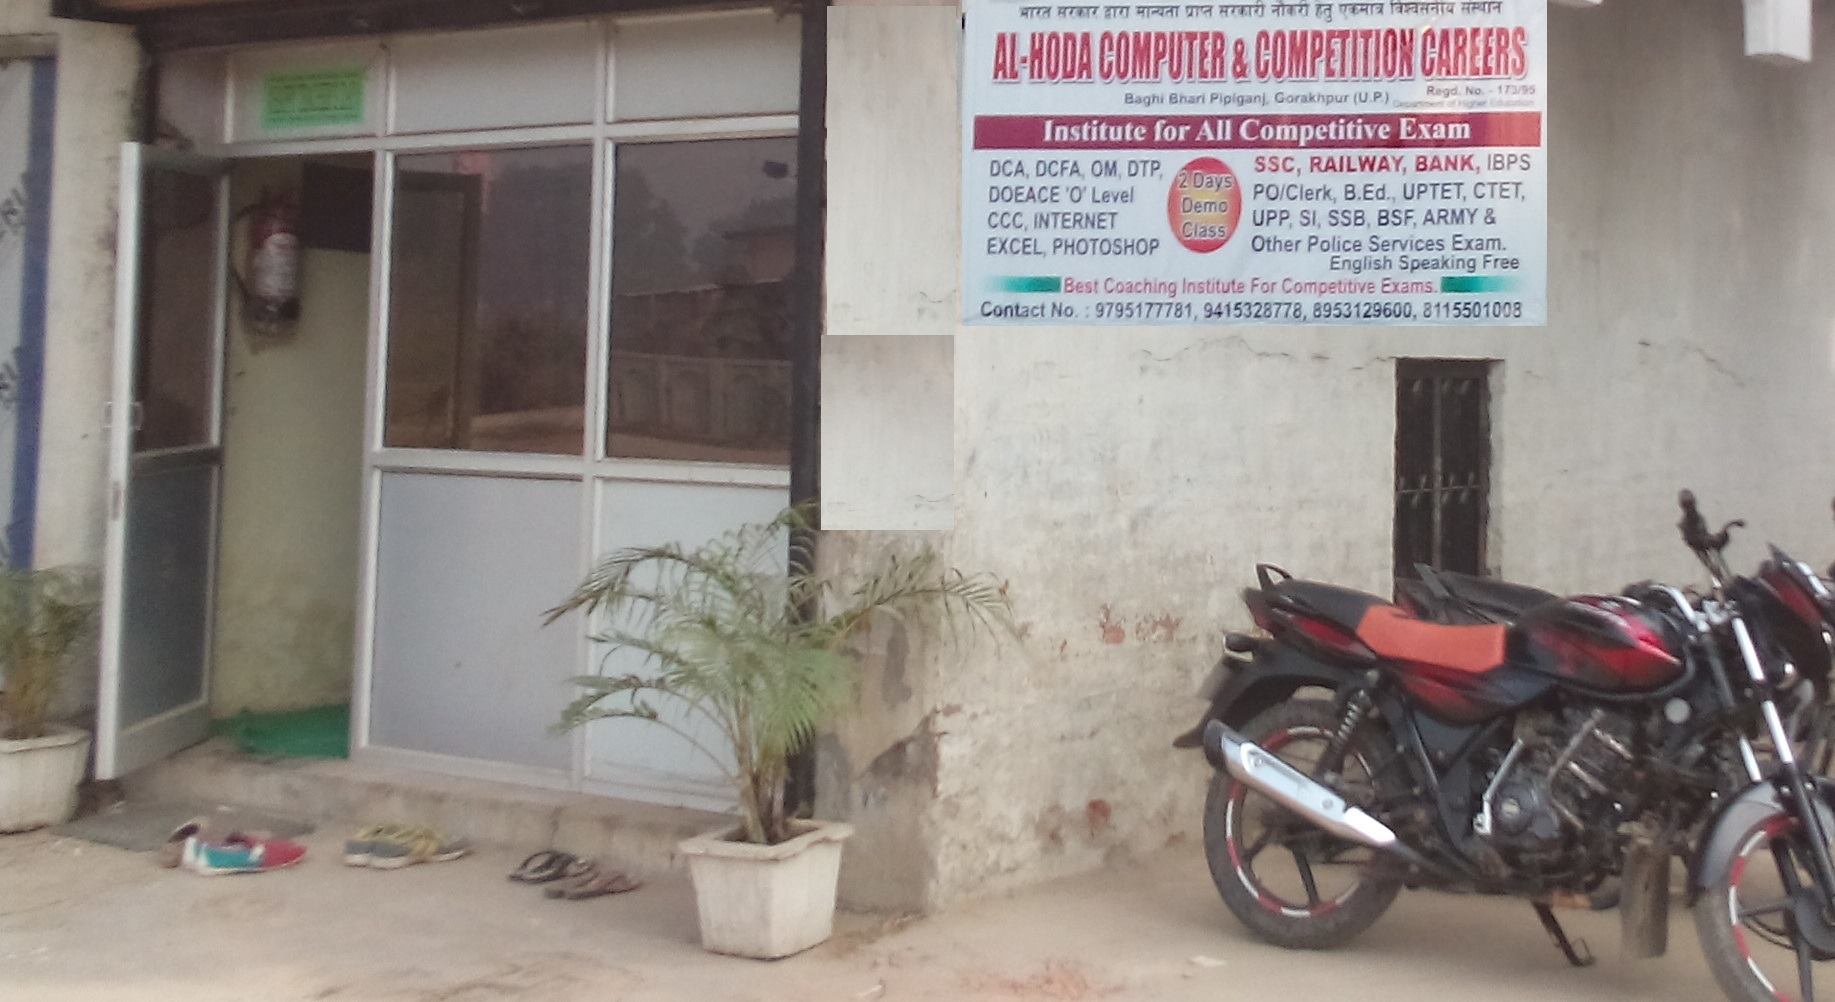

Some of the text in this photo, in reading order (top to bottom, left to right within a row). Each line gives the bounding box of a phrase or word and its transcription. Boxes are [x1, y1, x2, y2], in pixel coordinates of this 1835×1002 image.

[1057, 5, 1099, 18] सरकार
[1136, 4, 1180, 18] मान्यता
[992, 25, 1530, 83] AL-HODA COMPUTER & COMPETITION CAREERS
[1124, 93, 1164, 106] Baghi
[1168, 93, 1206, 104] Bhari
[1274, 91, 1349, 106] Gorakhpur
[1043, 117, 1472, 147] Institute for All Competitive Exam
[989, 159, 1164, 179] DCA, DCFA, OM, DTP,
[1253, 152, 1532, 177] SSC, RAILWAY, BANK, IBPS
[1178, 171, 1233, 192] 2 Days
[1252, 183, 1338, 202] PO/Clerk,
[1402, 182, 1468, 201] UPTET,
[1472, 180, 1526, 201] CTET,
[988, 186, 1061, 204] DOEACE
[1091, 185, 1135, 204] Level
[1181, 196, 1228, 214] Demo
[987, 211, 1119, 232] CCC, INTERNET
[1251, 206, 1497, 229] UPP, SI, SSB, BSF, ARMY &
[1181, 221, 1226, 239] Class
[986, 236, 1161, 258] EXCEL, PHOTOSHOP
[1250, 232, 1507, 253] Other Police Services Exam.
[1329, 253, 1520, 274] English Speaking Free
[1064, 275, 1438, 298] Best Coaching Institute For Competitive Exams.
[980, 301, 1046, 319] Contact
[1051, 302, 1080, 318] No.
[1095, 301, 1199, 321] 9795177781,
[1203, 302, 1308, 321] 9415328778,
[1423, 301, 1523, 319] 8115501008
